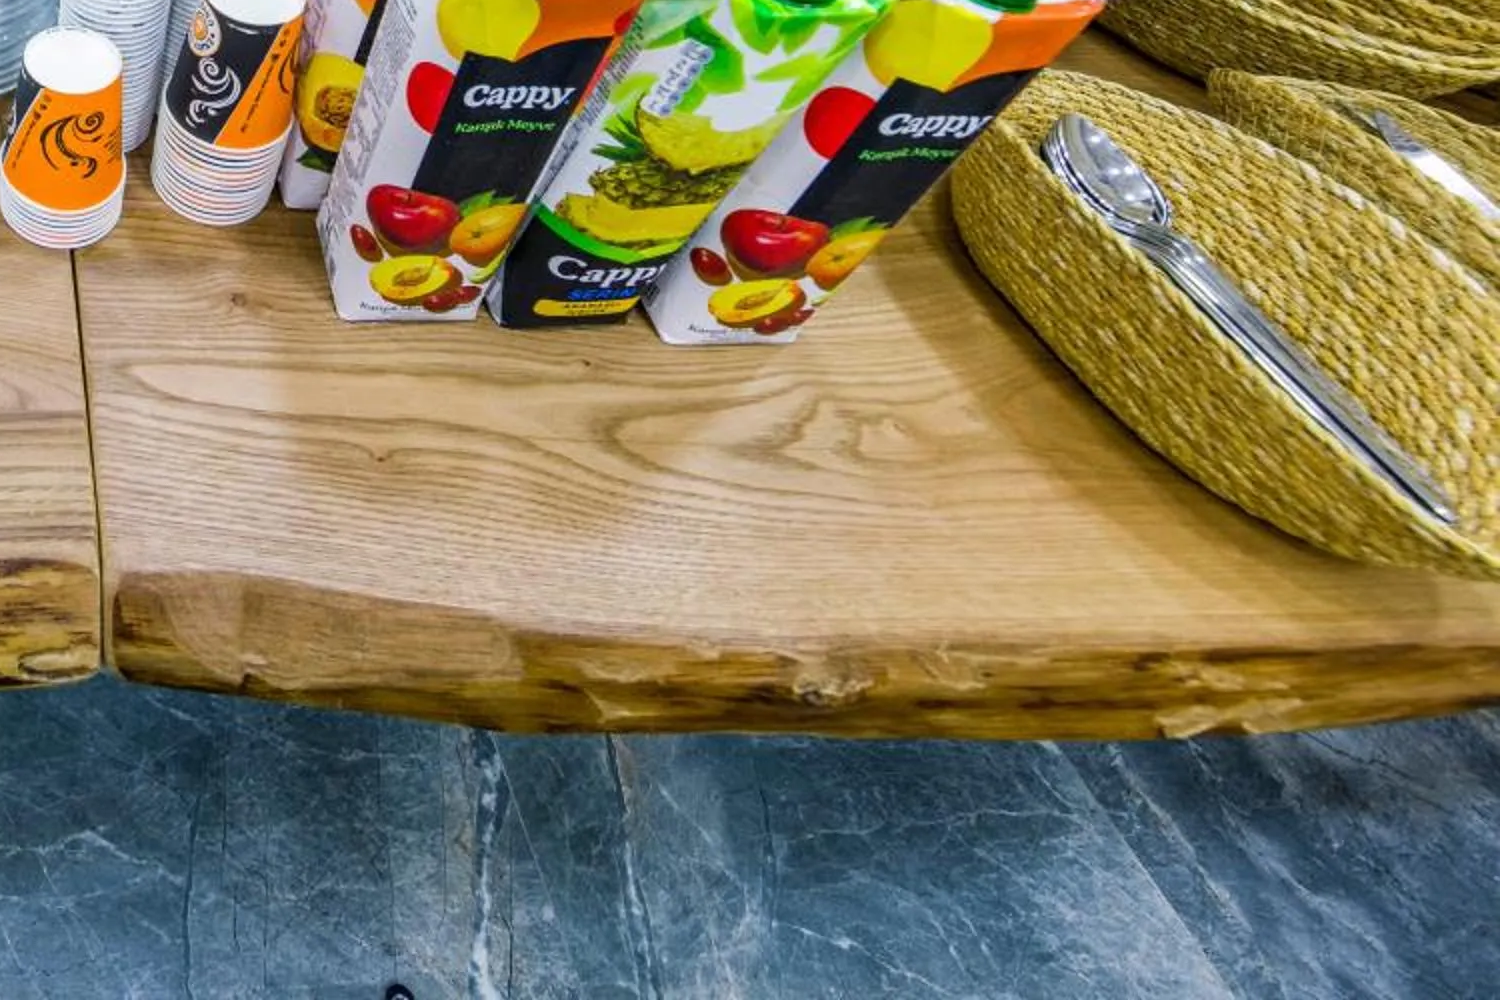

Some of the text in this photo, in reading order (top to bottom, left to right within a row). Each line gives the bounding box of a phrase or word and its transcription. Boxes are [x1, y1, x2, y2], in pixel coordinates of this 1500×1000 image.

[463, 83, 576, 110] Cappy
[878, 112, 995, 139] Cappy
[548, 255, 667, 289] Capp
